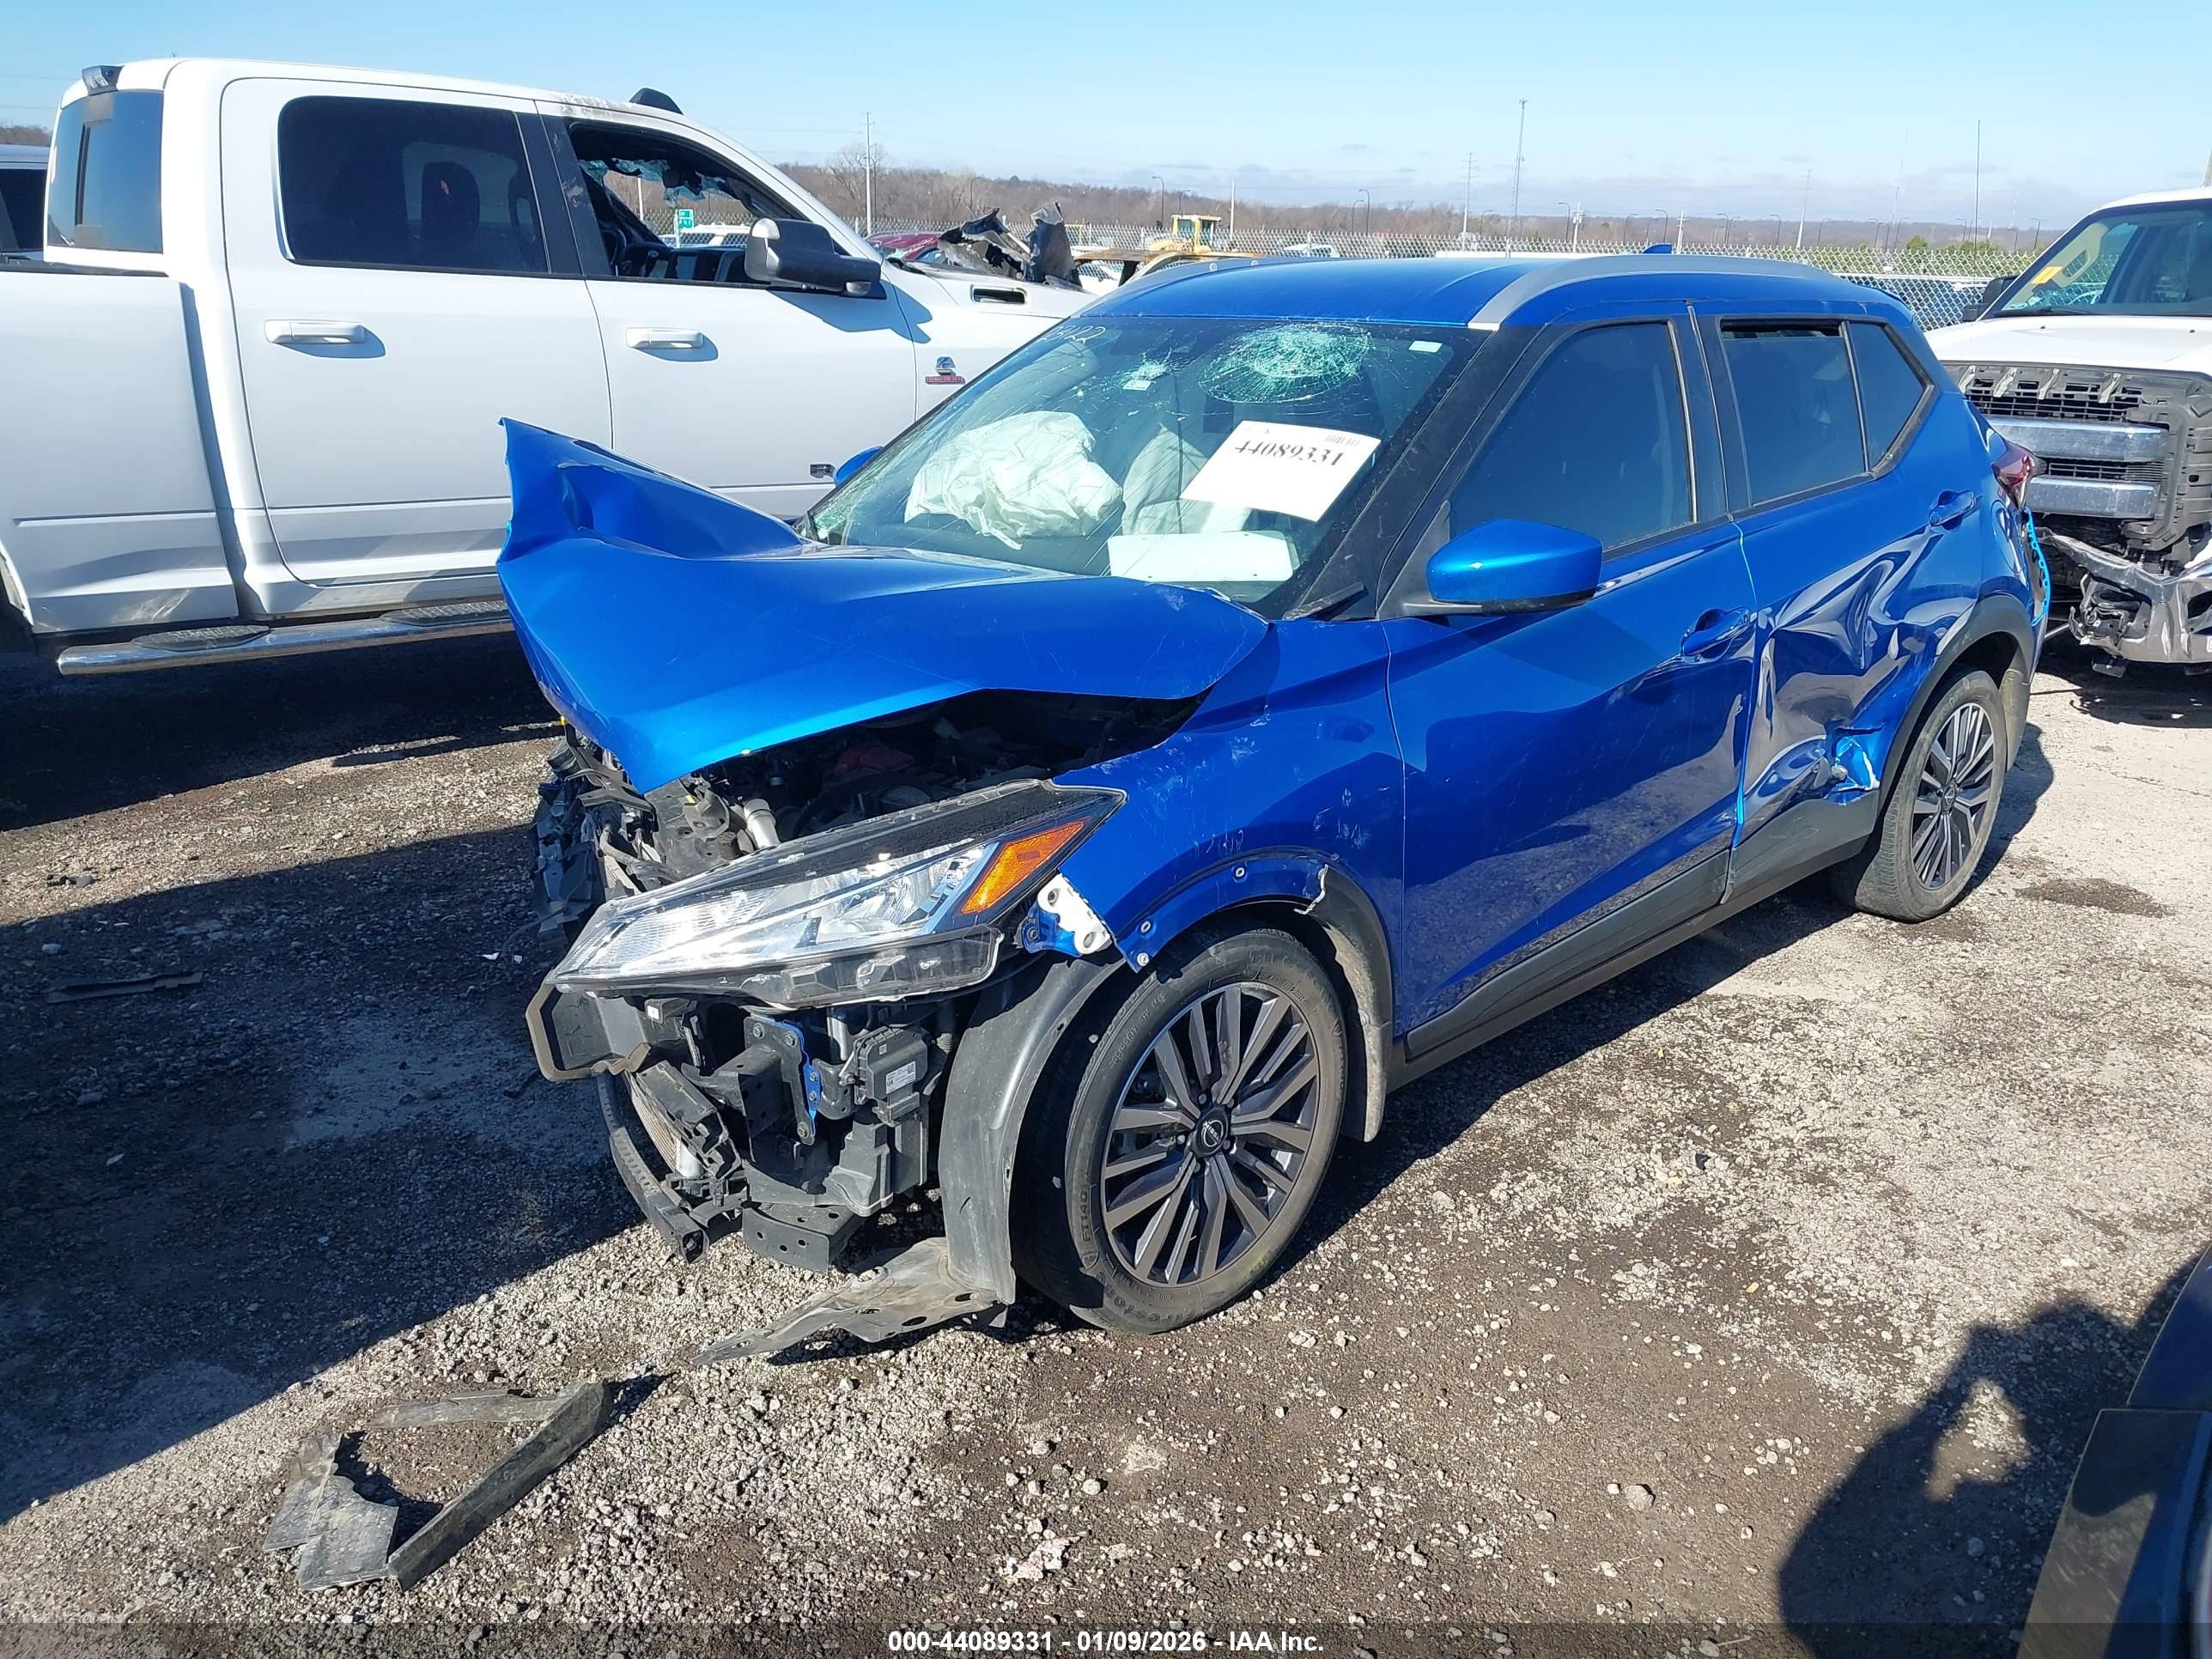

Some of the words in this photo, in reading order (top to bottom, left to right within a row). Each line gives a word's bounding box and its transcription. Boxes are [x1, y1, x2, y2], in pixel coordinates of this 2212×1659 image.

[1234, 440, 1345, 466] 44089331
[1079, 1190, 1091, 1243] FT140
[1098, 1271, 1194, 1322] irestone
